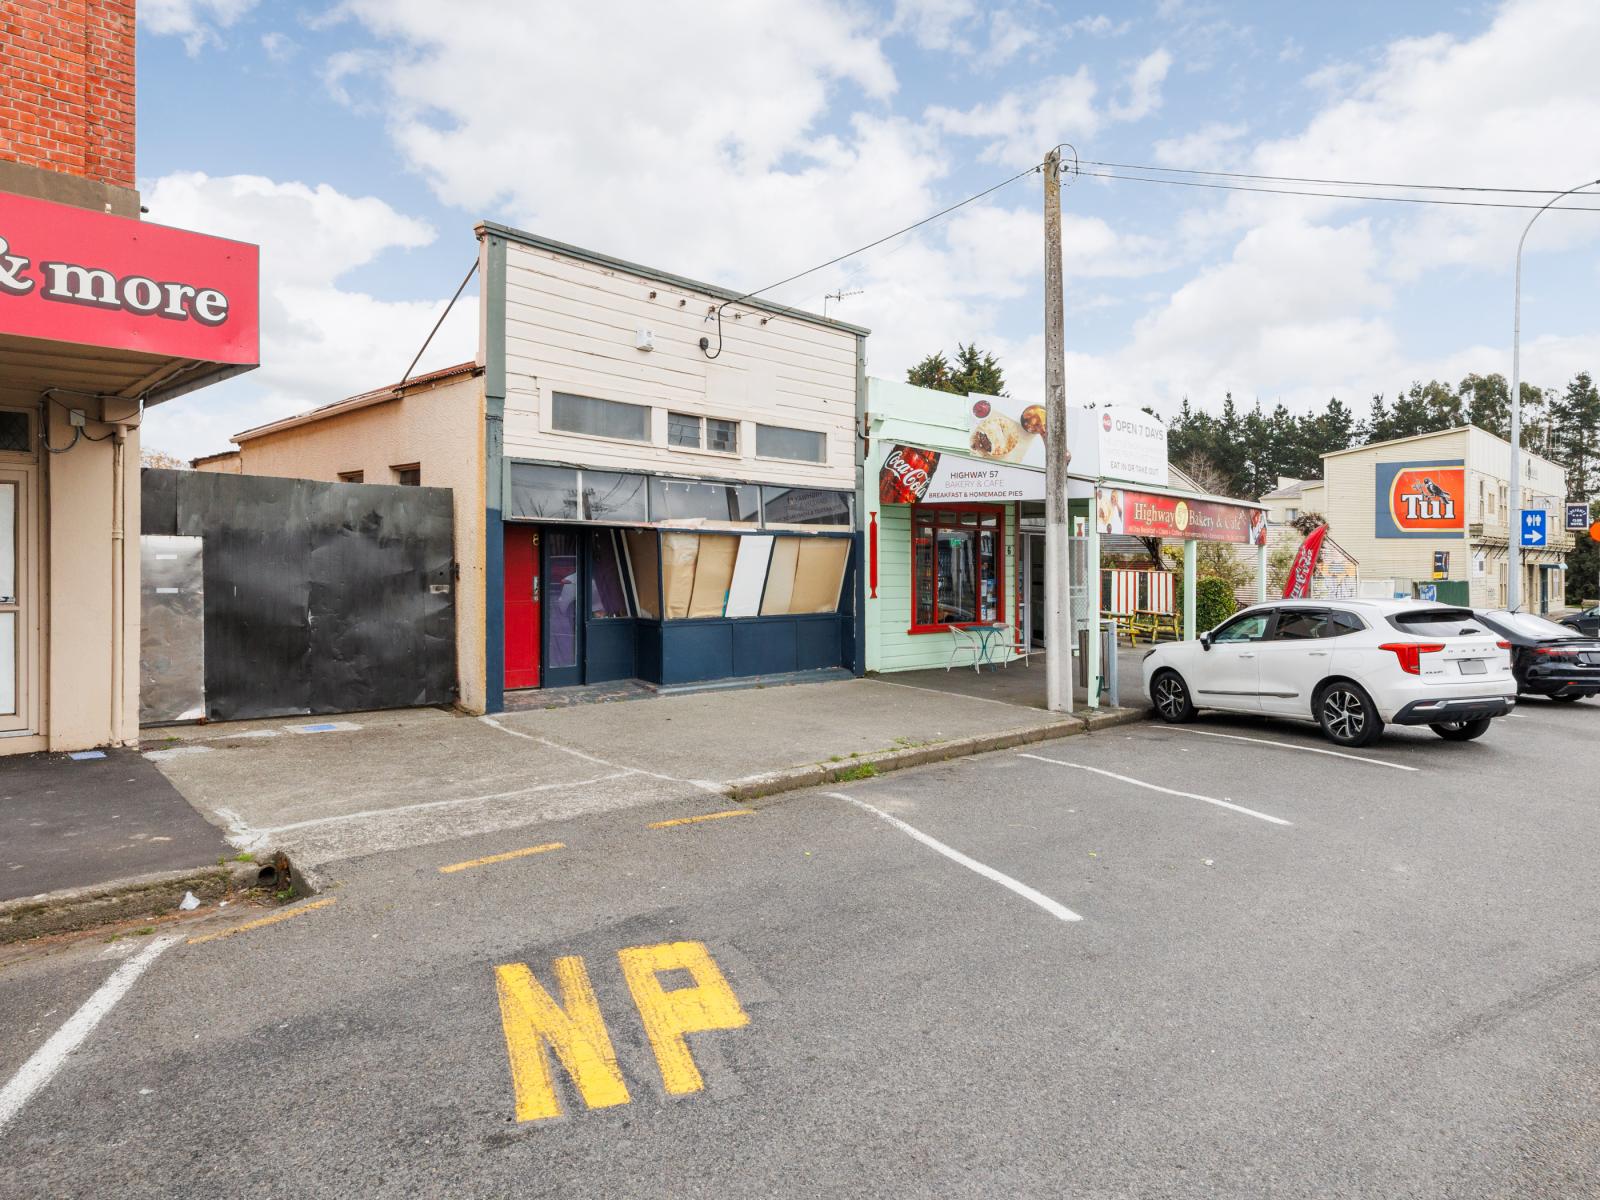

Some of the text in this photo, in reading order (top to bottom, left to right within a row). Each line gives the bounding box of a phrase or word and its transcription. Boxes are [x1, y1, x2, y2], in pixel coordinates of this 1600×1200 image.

[41, 261, 228, 327] more
[1116, 419, 1137, 435] OPEN
[1138, 424, 1143, 436] 7
[1145, 427, 1163, 440] DAYS
[1110, 461, 1120, 469] EAT
[950, 470, 999, 480] HIGHWAY 57
[945, 479, 1005, 489] BAKERY & CAFE
[928, 491, 963, 499] BREAKFAST
[963, 491, 968, 499] &
[1400, 493, 1456, 519] Tui
[1134, 503, 1175, 529] Highway
[1189, 509, 1214, 531] Bakery
[532, 533, 540, 546] 8
[494, 941, 751, 1123] NP
